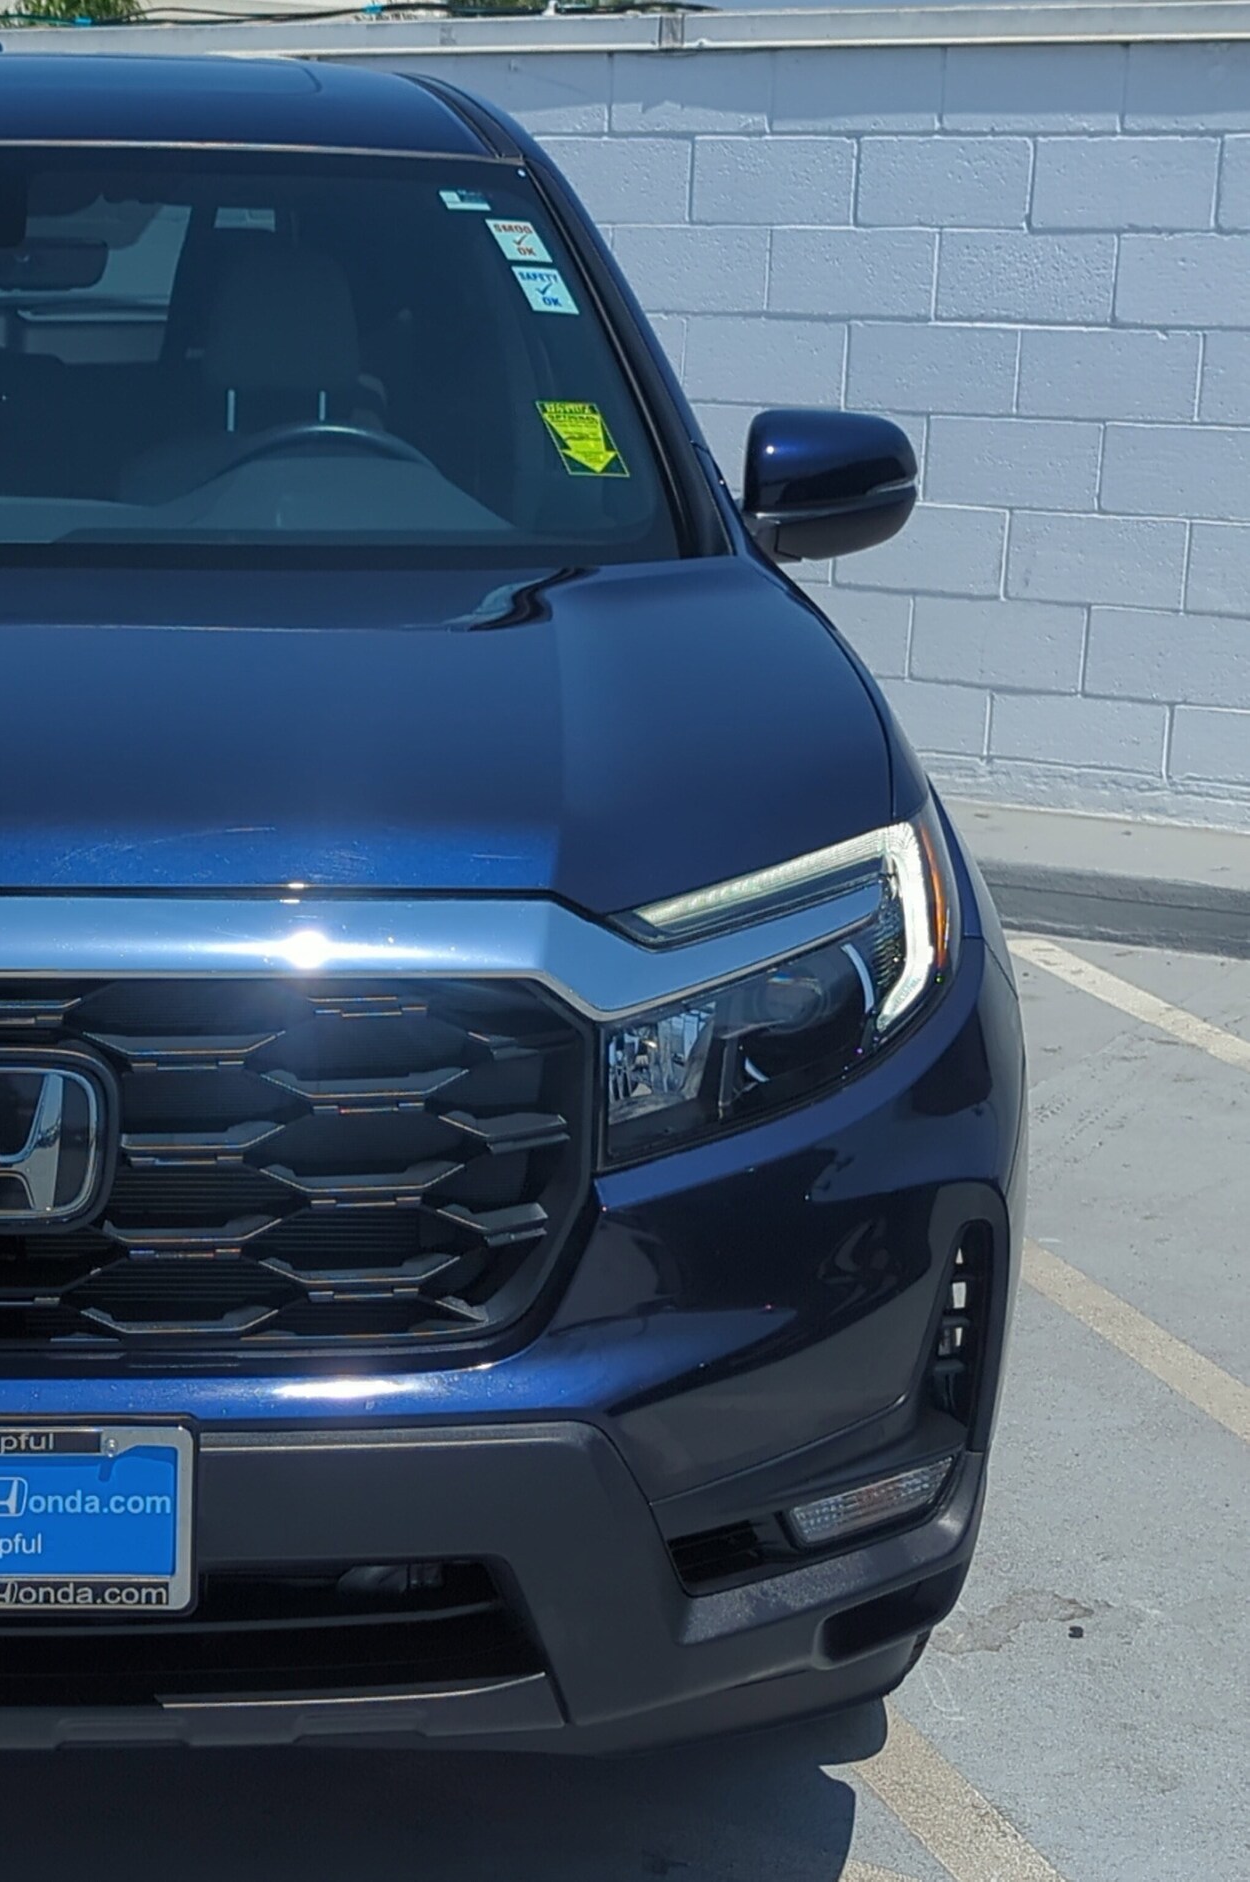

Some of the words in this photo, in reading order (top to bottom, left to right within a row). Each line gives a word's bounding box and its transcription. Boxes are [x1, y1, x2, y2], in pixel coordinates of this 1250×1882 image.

[493, 223, 533, 234] SMOG
[516, 247, 536, 256] OK
[518, 271, 558, 283] SAFETY
[542, 296, 562, 307] OK
